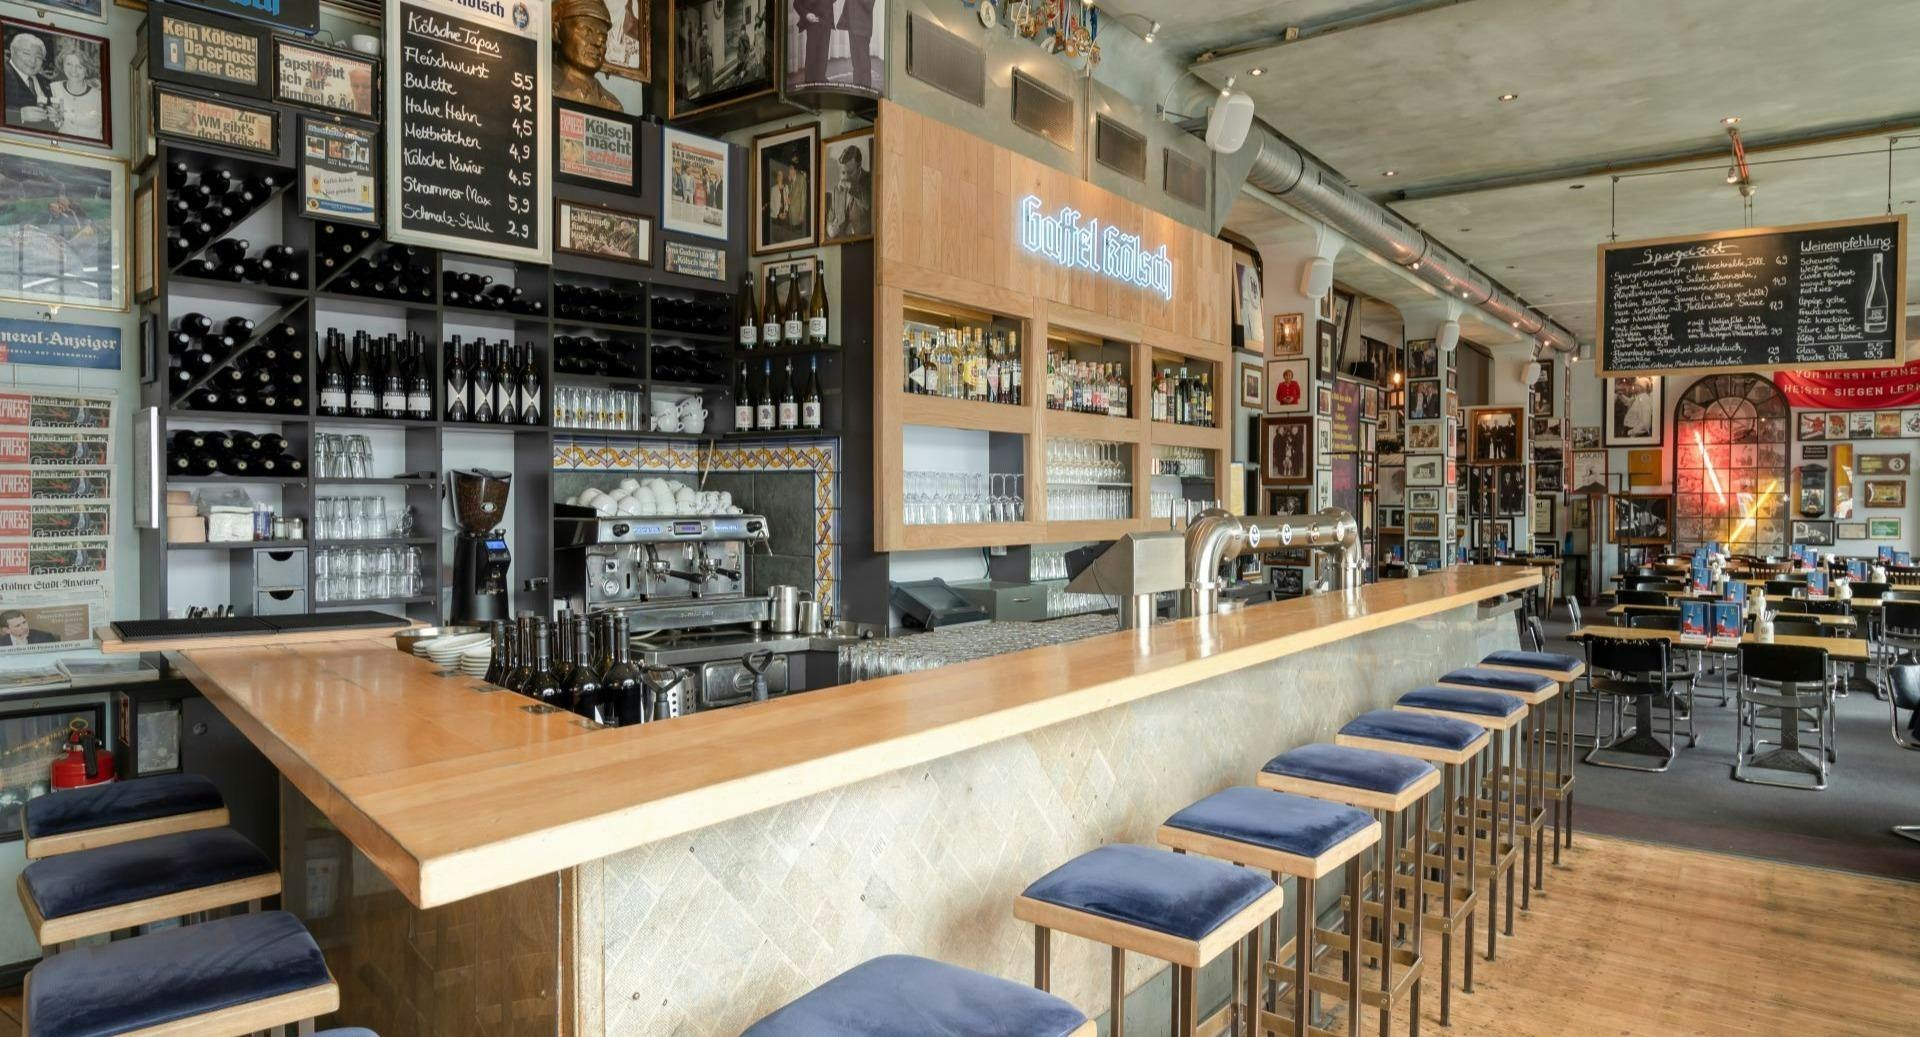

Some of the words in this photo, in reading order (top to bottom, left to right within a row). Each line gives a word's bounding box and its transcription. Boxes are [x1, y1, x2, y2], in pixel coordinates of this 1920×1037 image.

[163, 17, 199, 42] Kein
[201, 26, 256, 52] Kölsch!
[408, 12, 462, 43] Kölsche
[459, 27, 501, 54] Tapas
[184, 38, 204, 57] Da
[206, 46, 256, 68] schoss
[199, 58, 222, 76] der
[224, 62, 256, 82] Gast
[404, 46, 490, 79] Fleischwurst
[510, 71, 534, 91] 5,5
[305, 78, 325, 91] auf
[403, 72, 458, 95] Bulette
[512, 94, 533, 113] 3,2
[197, 113, 221, 130] WM
[223, 119, 255, 137] gibt's
[405, 95, 444, 118] Halve
[445, 101, 482, 127] Hahn
[511, 118, 533, 139] 4,5
[585, 118, 632, 141] Kölsch
[404, 122, 482, 150] Mettbrötchen
[508, 143, 530, 163] 4,9
[585, 136, 632, 156] macht
[449, 152, 485, 175] Kaviar
[402, 176, 464, 200] Strammer
[466, 184, 493, 207] Max
[508, 194, 531, 215] 5,9
[402, 203, 495, 234] Schmalz-Stulle
[506, 220, 529, 239] 2,9
[1022, 194, 1100, 272] Gaffel
[1103, 225, 1173, 300] Kölsch
[1800, 233, 1891, 254] Weinempfehlung
[0, 331, 117, 351] neral-Anzeiger
[1872, 366, 1920, 380] LERNE
[1784, 383, 1827, 396] HEISST
[1833, 386, 1883, 397] SIEGEN
[1890, 383, 1920, 395] LERN
[1893, 459, 1901, 469] 3
